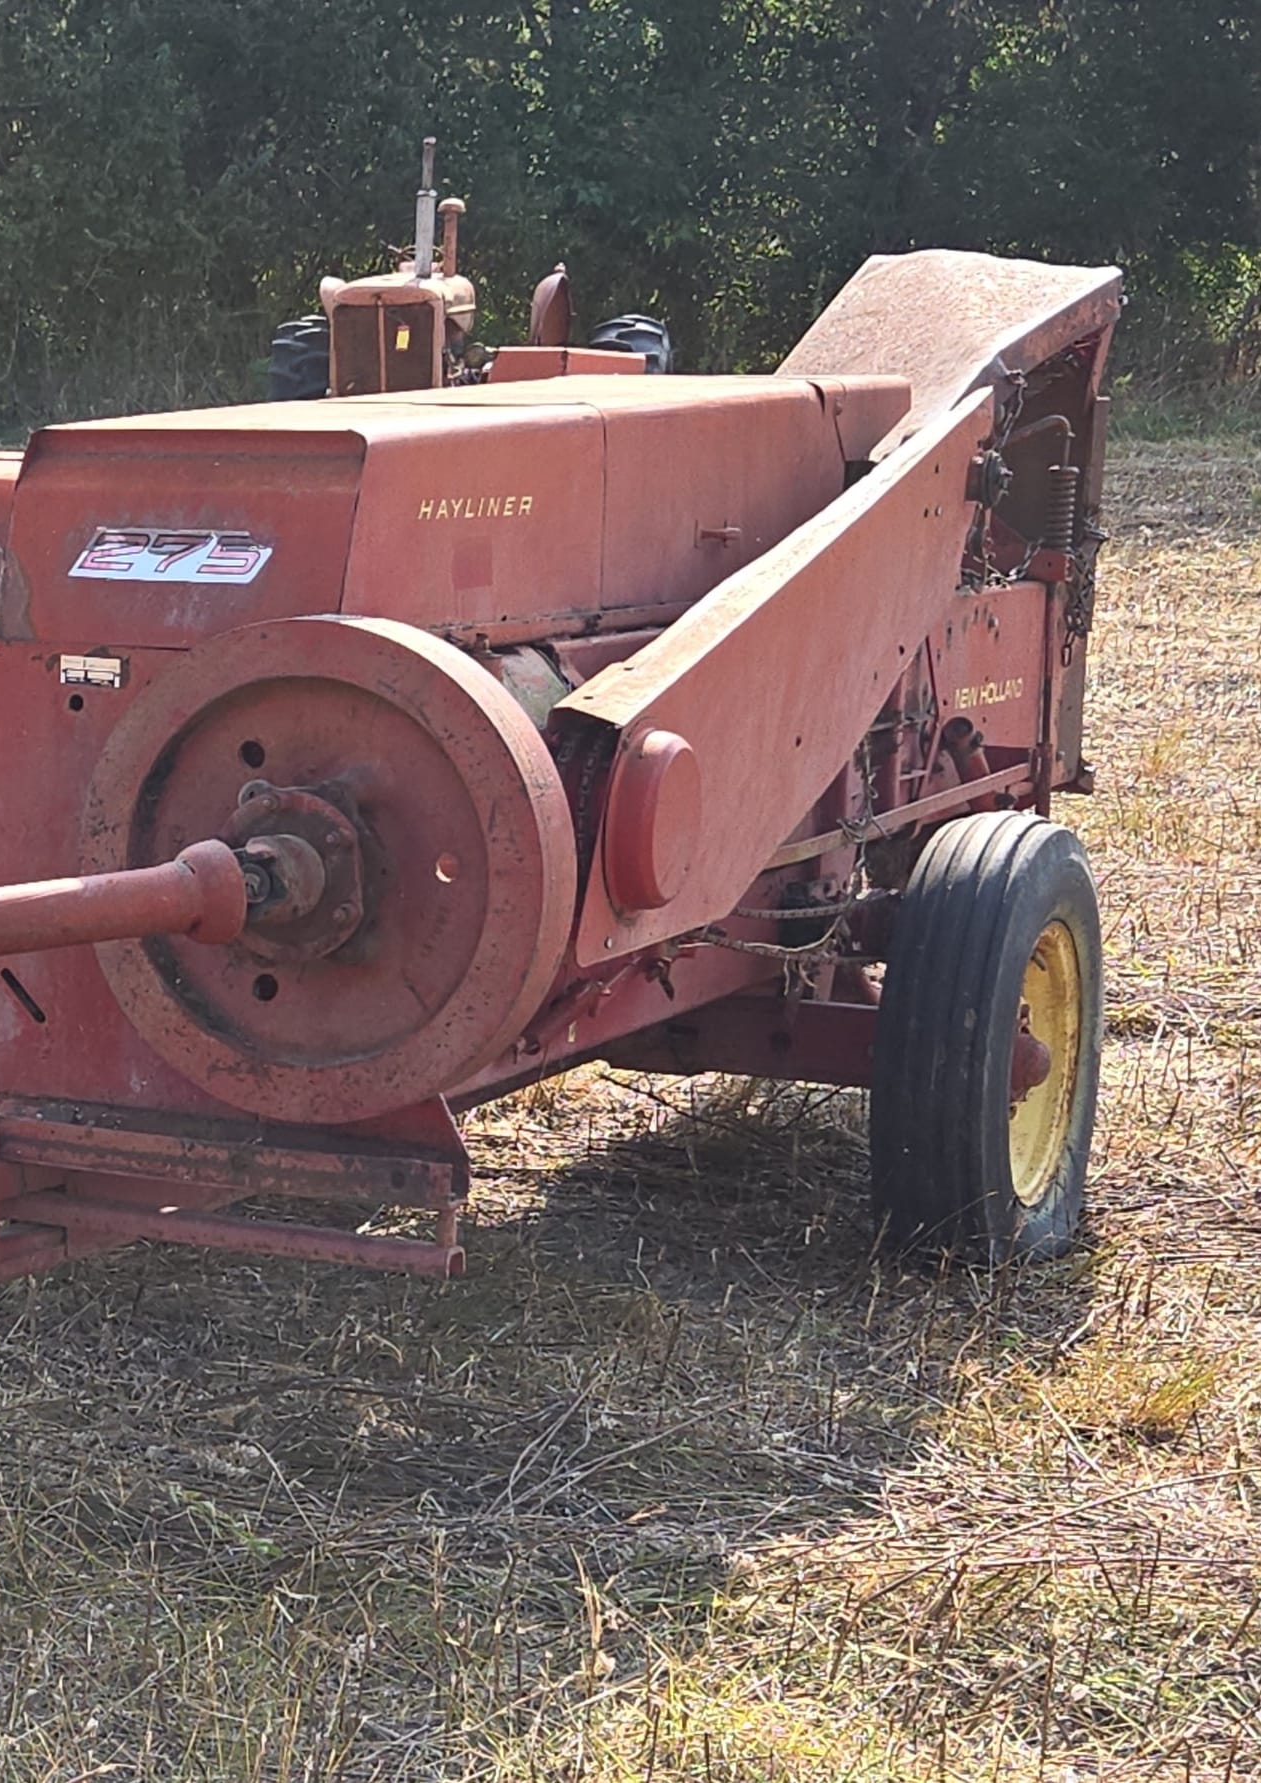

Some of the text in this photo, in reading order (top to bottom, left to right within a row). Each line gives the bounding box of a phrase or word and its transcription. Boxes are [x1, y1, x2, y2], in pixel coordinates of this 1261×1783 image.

[417, 495, 533, 521] HAYLINER
[76, 530, 263, 577] 275
[954, 677, 1024, 710] NEW HOLLAND
